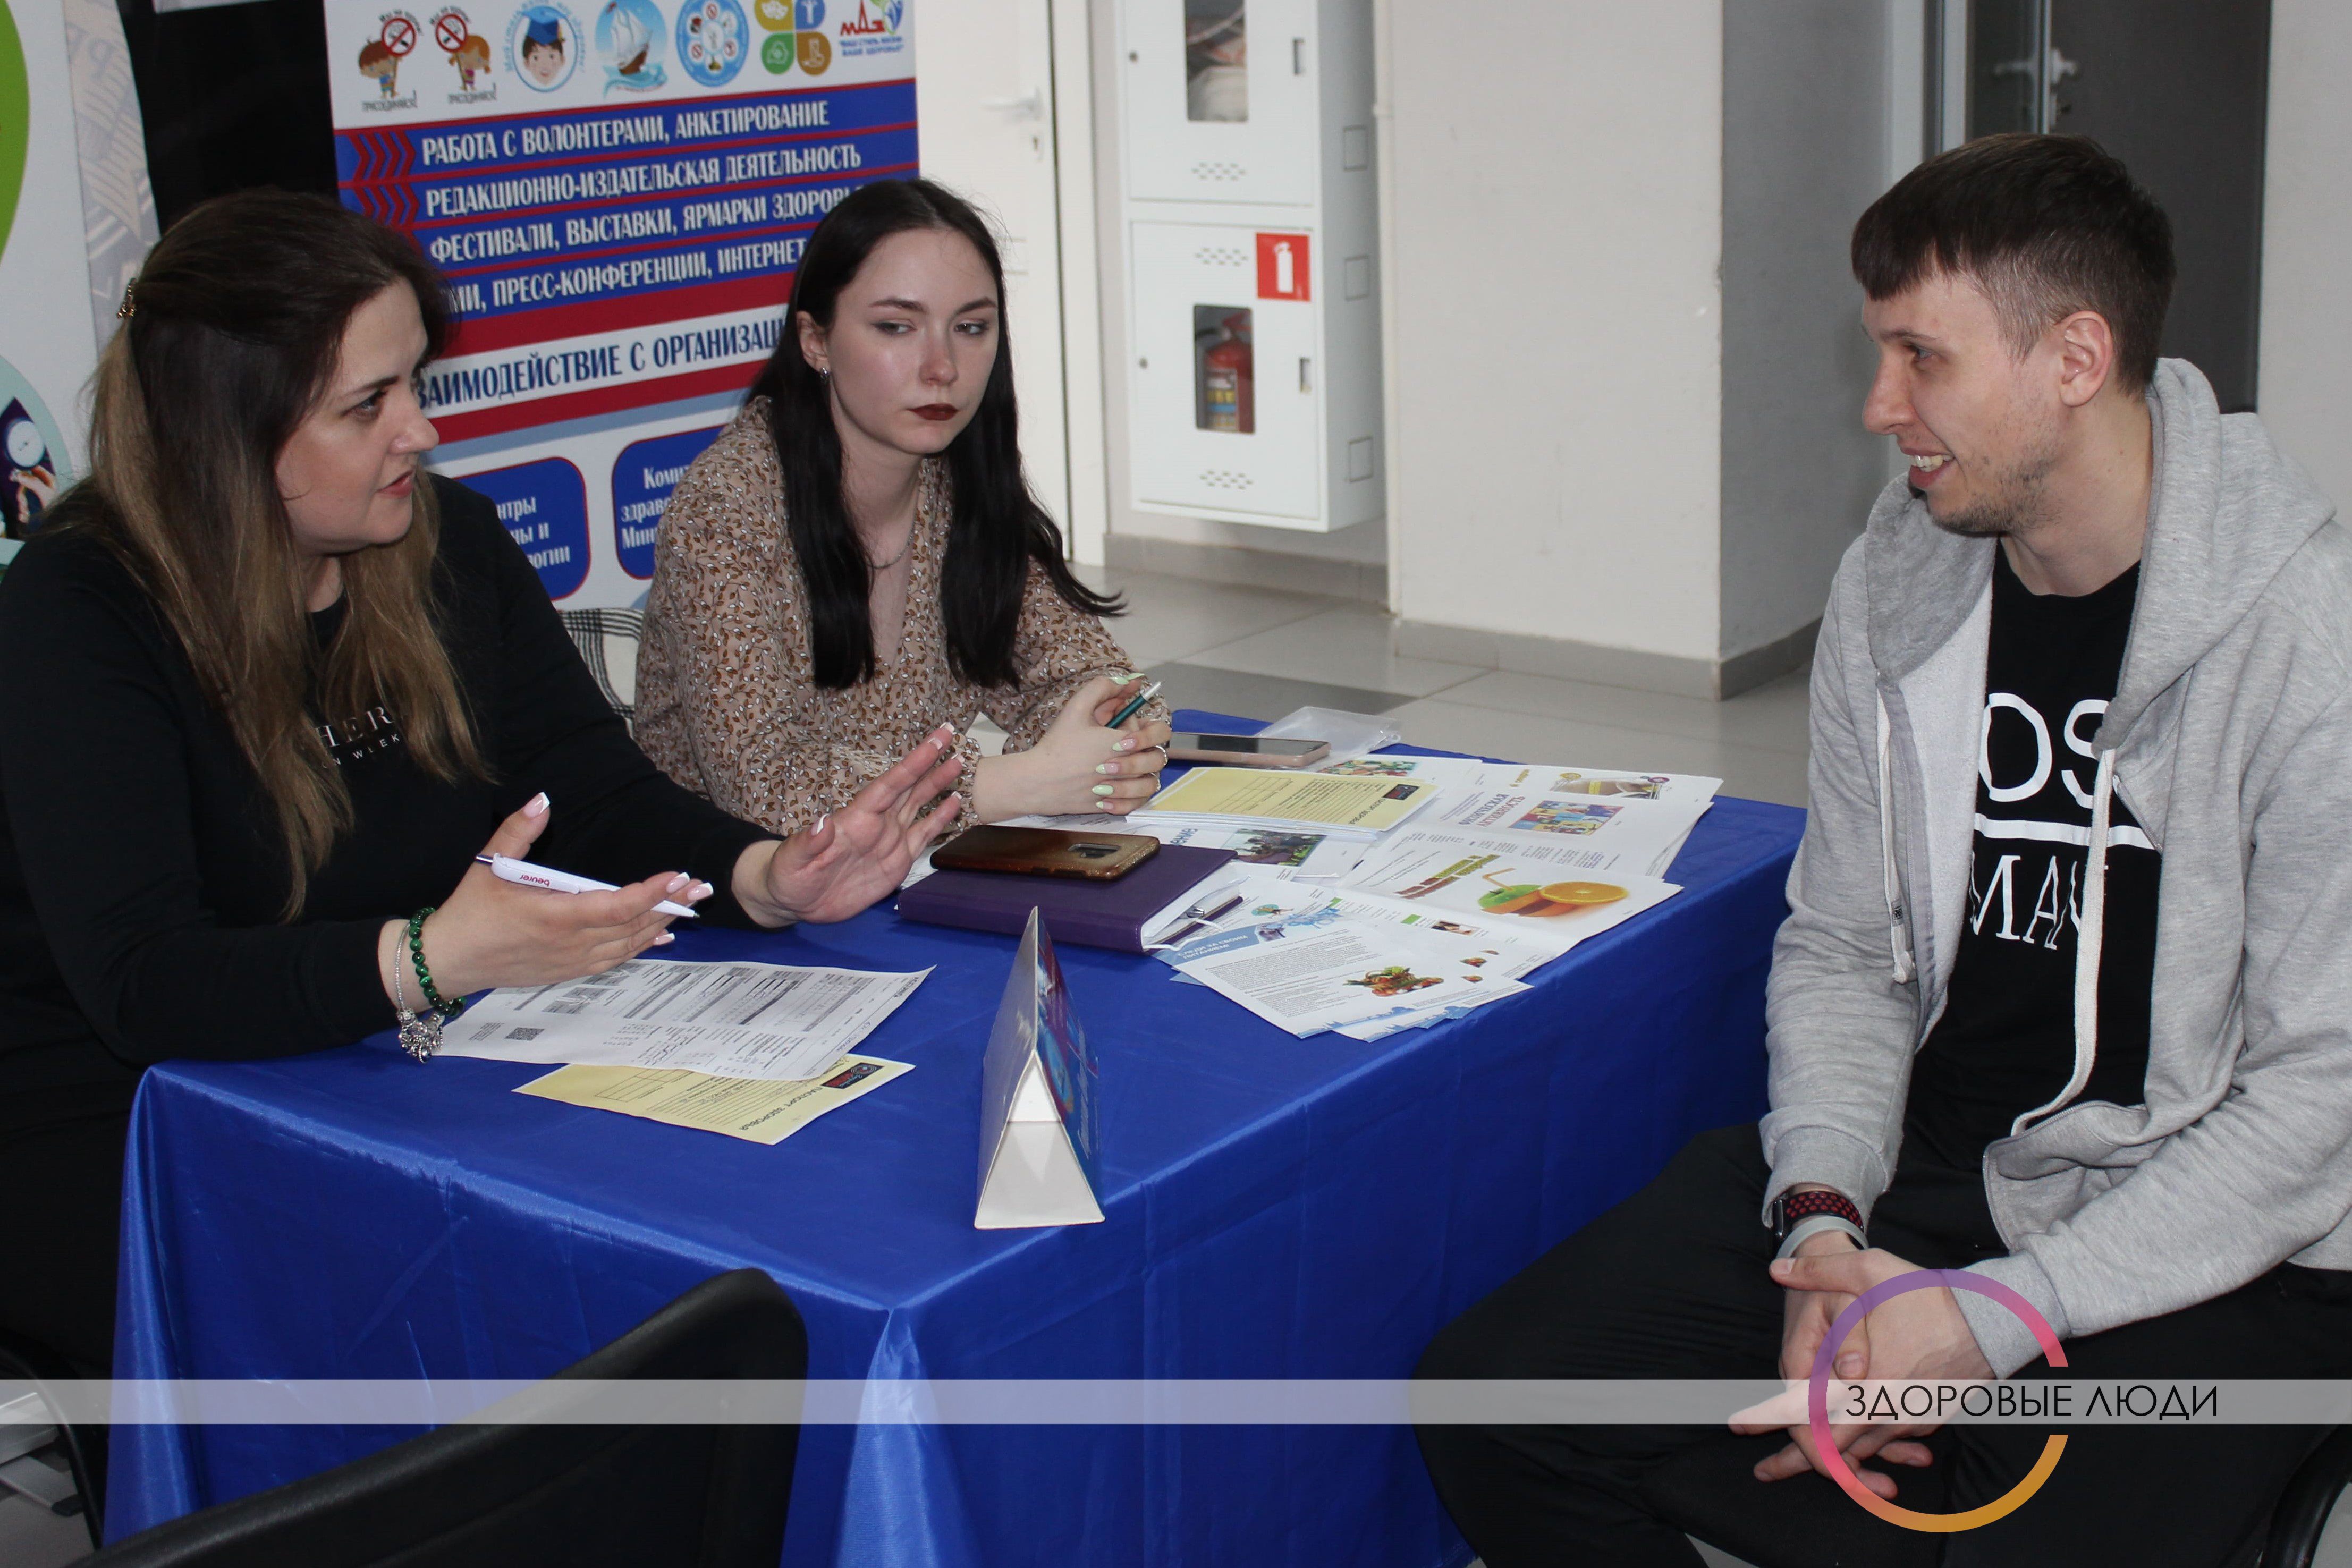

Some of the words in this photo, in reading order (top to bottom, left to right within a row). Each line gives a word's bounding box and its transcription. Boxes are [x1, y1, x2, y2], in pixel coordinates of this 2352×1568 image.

[422, 132, 498, 166] РАБОТА
[502, 129, 517, 157] С
[522, 115, 670, 155] ВОЛОНТЕРАМИ,
[675, 100, 830, 139] АНКЕТИРОВАНИЕ
[426, 158, 721, 217] РЕДАКЦИОННО-ИЗДАТЕЛЬСКАЯ
[726, 143, 861, 183] ДЕЯТЕЛЬНОСТЬ
[430, 223, 560, 263] ФЕСТИВАЛИ,
[566, 208, 678, 247] ВЫСТАВКИ,
[683, 196, 767, 231] ЯРМАРКИ
[493, 251, 713, 307] ПРЕСС-КОНФЕРЕНЦИИ,
[418, 345, 623, 409] ЗАИМОДЕЙСТВИЕ
[630, 342, 646, 372] С
[496, 496, 537, 522] нтры
[538, 522, 549, 540] и
[519, 875, 550, 887] beurer
